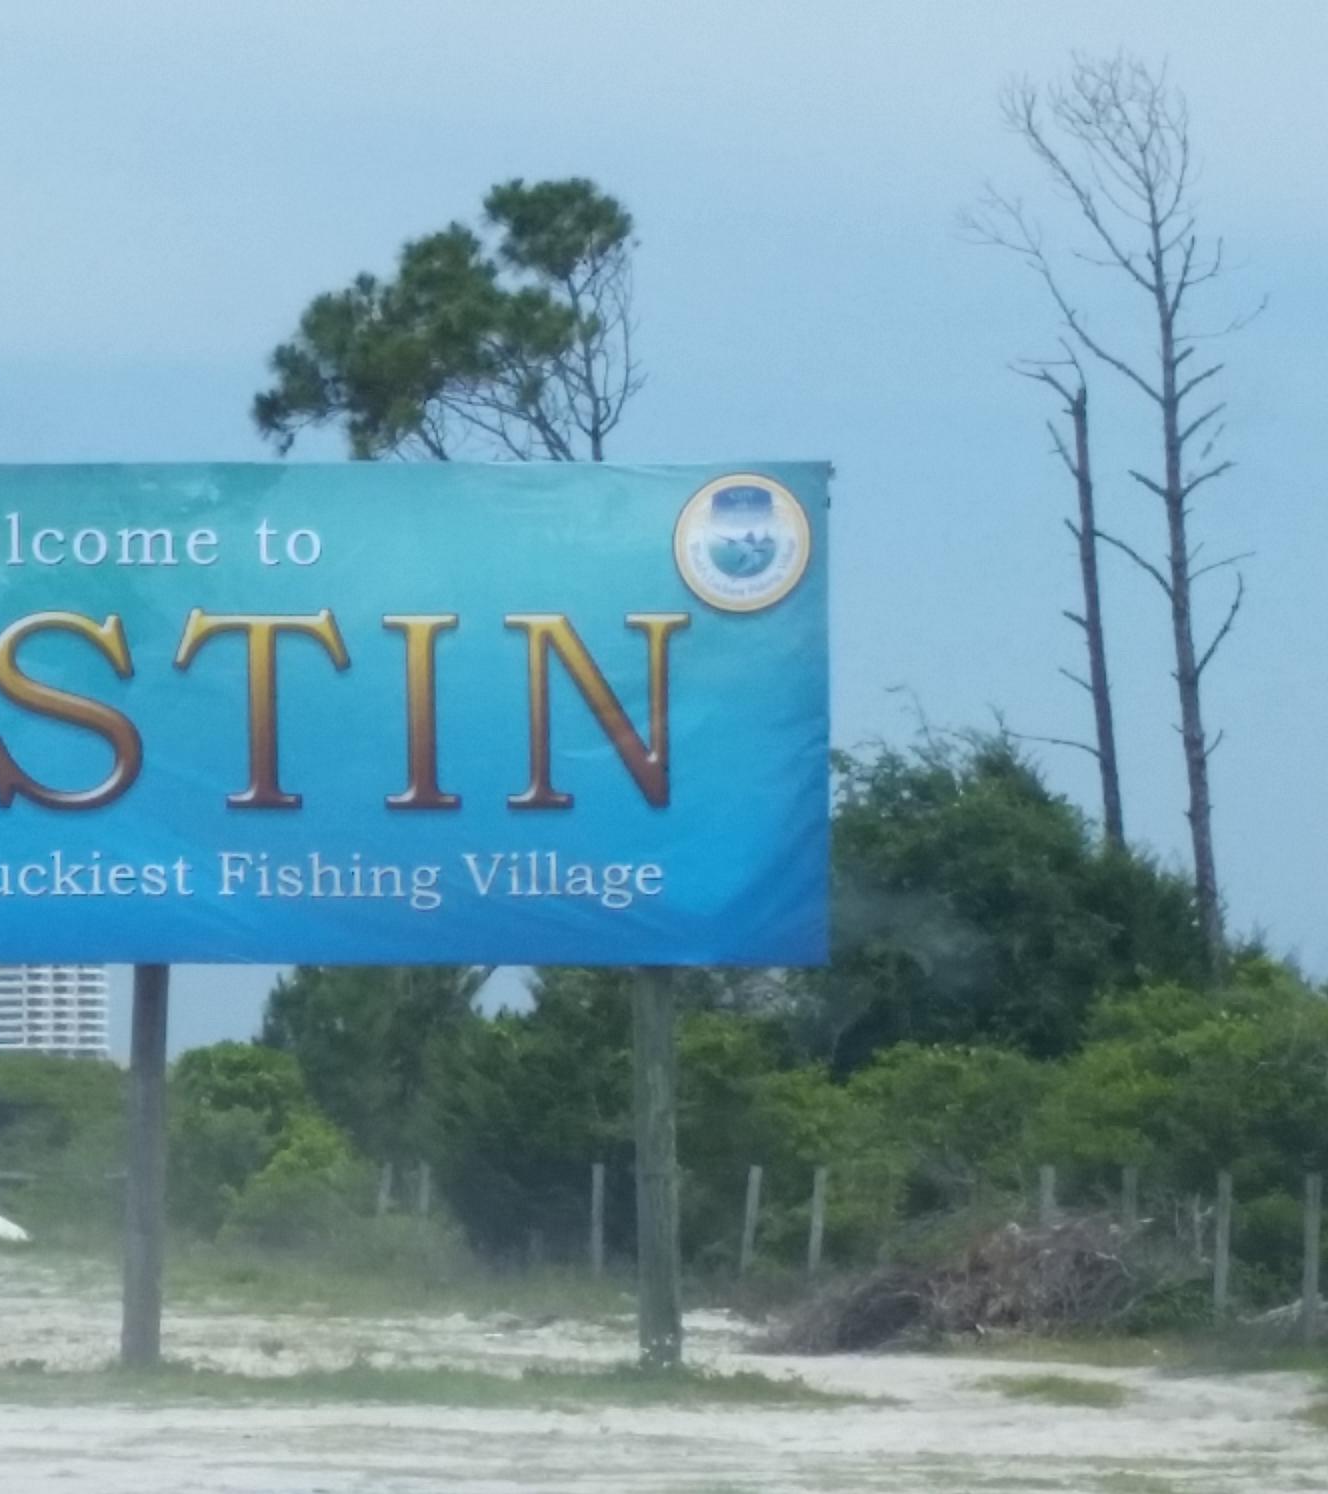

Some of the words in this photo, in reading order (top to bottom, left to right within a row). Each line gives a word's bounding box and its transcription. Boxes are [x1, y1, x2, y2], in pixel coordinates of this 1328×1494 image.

[255, 518, 322, 567] to
[217, 850, 443, 911] Fishing
[462, 851, 664, 910] Village
